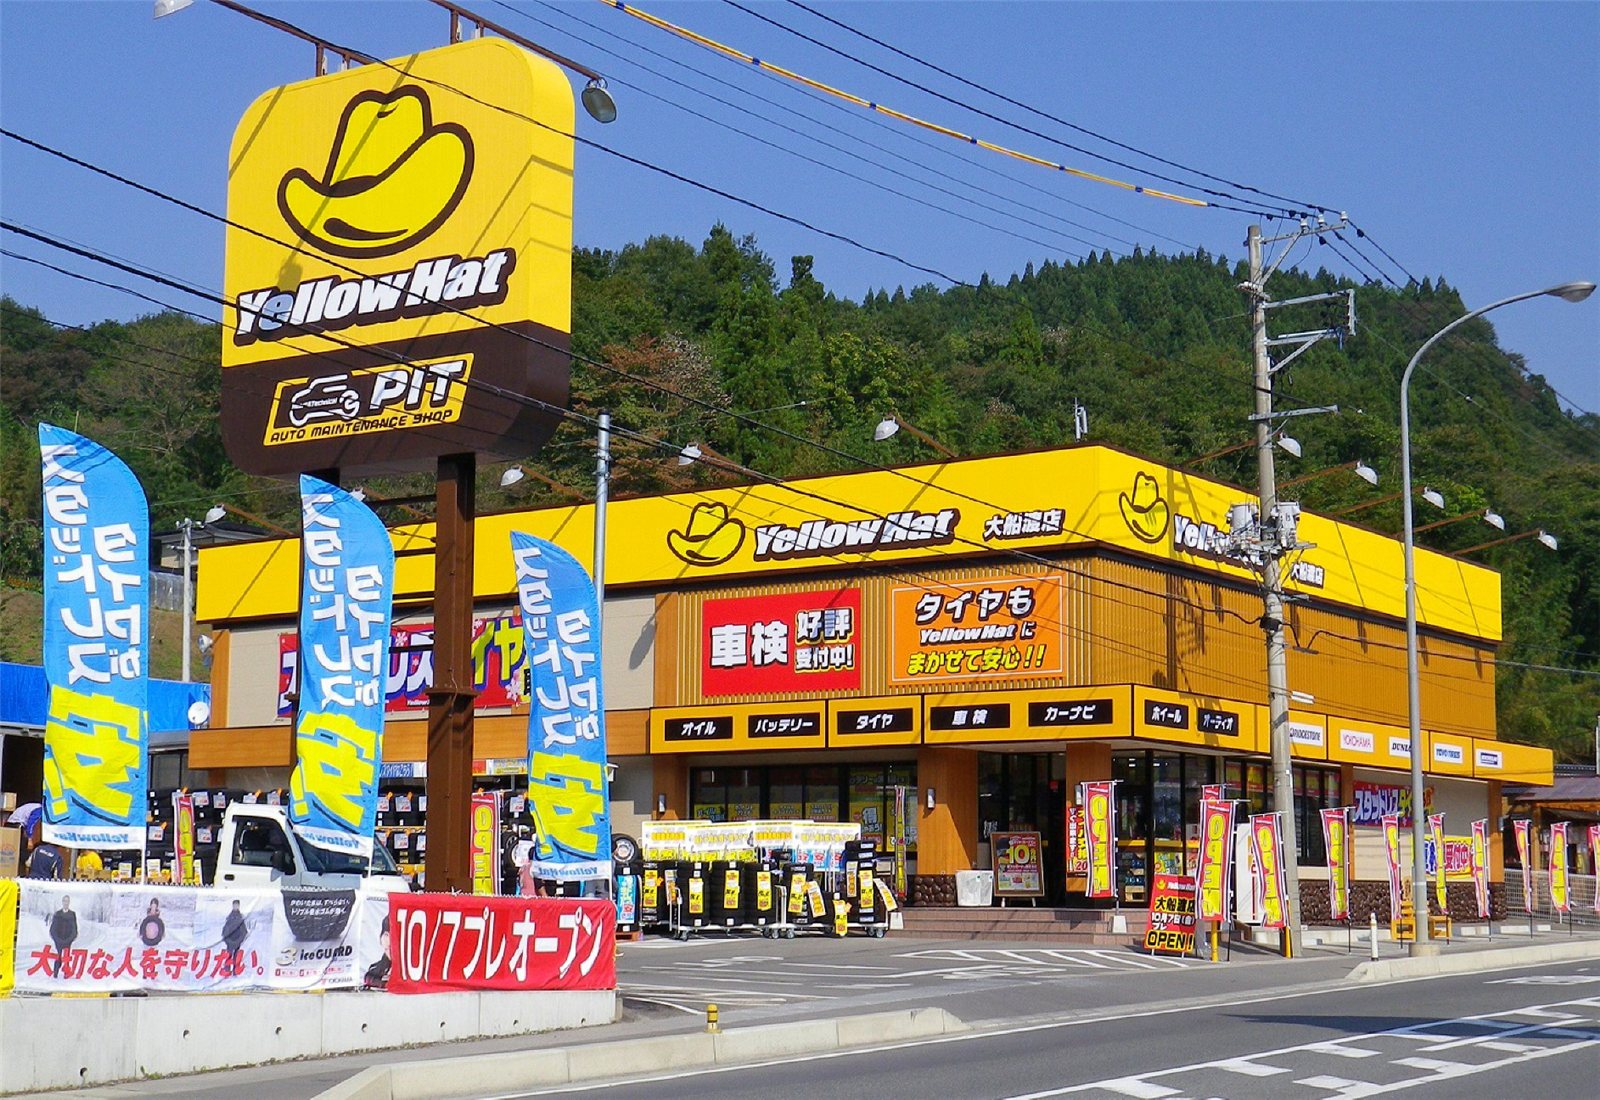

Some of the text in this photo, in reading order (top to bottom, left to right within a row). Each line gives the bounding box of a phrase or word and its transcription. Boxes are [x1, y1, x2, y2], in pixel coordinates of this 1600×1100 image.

[369, 360, 464, 410] PIT
[270, 409, 453, 443] AUTO MAINTENANCE SHOP
[983, 509, 1064, 538] 大船渡店
[916, 586, 1035, 622] タイヤも
[796, 608, 852, 641] 好評
[1021, 621, 1035, 638] に
[709, 620, 788, 668] 車検
[795, 644, 853, 673] 受付中!
[907, 644, 1047, 675] まかせて安心!!
[680, 720, 717, 736] オイル
[754, 716, 814, 735] バッテリー
[856, 713, 893, 731] タイヤ
[1151, 706, 1182, 724] ホイール
[1342, 734, 1372, 749] YOKOHAMA
[396, 905, 603, 983] 10/7プレオープン
[28, 943, 265, 980] 大切な人を守りたい。
